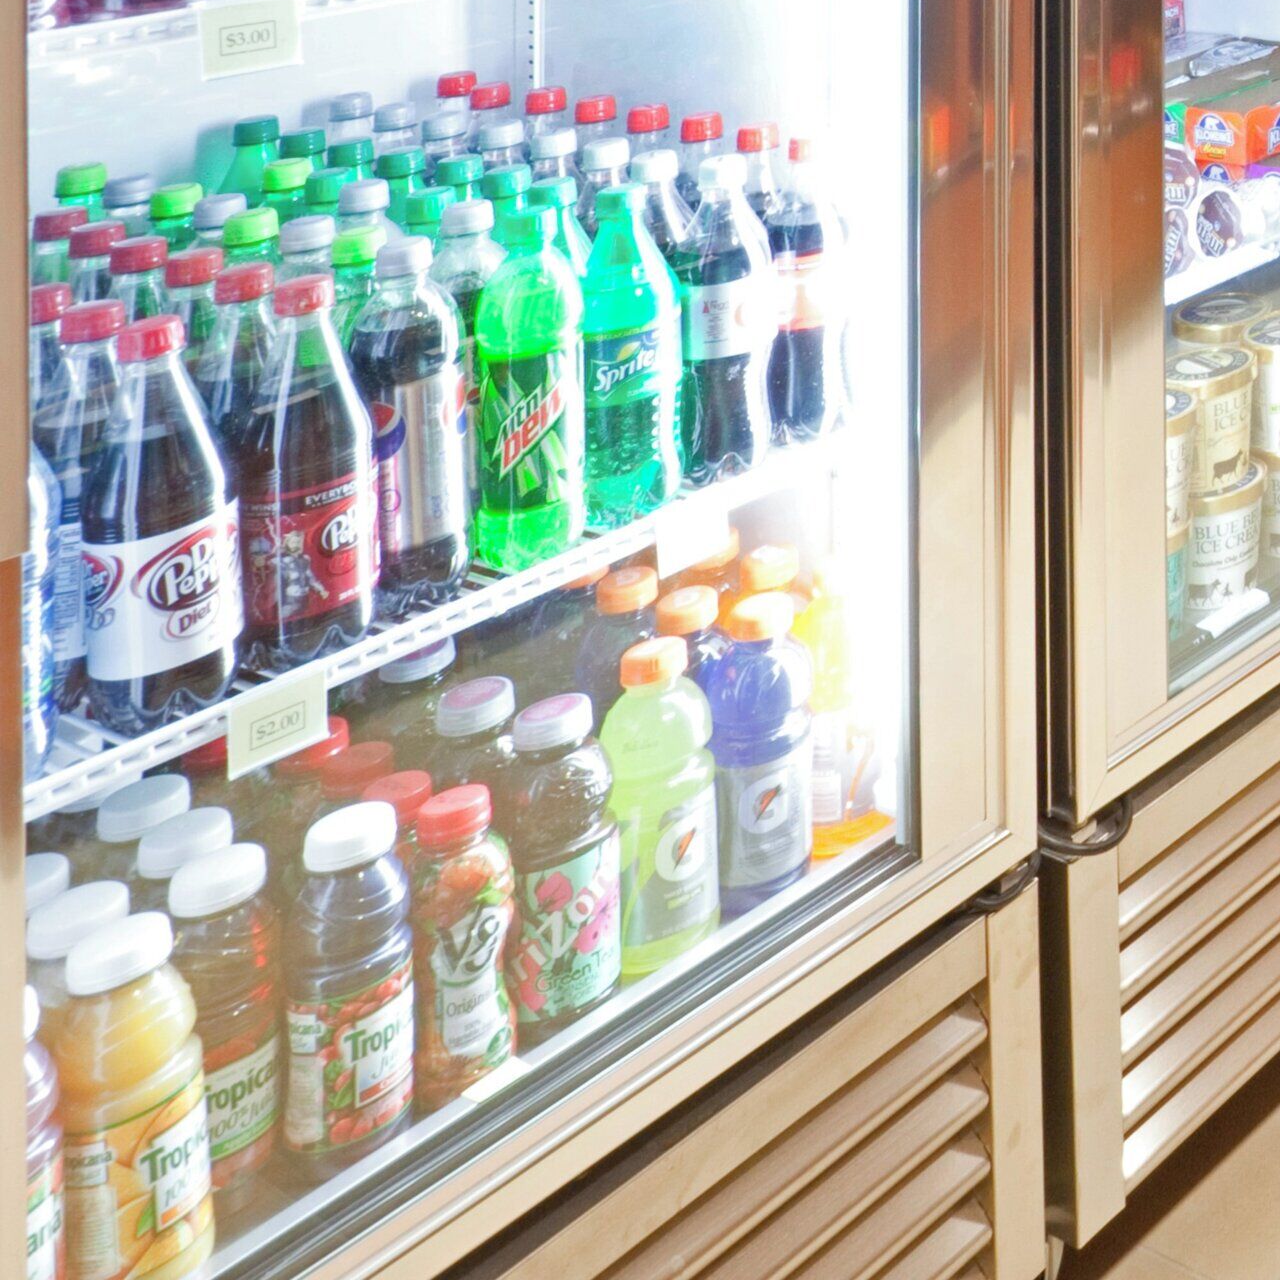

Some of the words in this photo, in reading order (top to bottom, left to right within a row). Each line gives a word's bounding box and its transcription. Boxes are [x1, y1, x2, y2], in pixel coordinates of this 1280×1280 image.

[225, 26, 272, 51] $3.00
[593, 348, 657, 392] Sprite
[1214, 416, 1237, 432] ICE
[1195, 521, 1239, 542] BLUE
[1196, 541, 1222, 555] ICE
[1225, 527, 1259, 550] CREA
[179, 602, 212, 634] Diet
[256, 711, 299, 740] $2.00
[536, 964, 591, 993] Green
